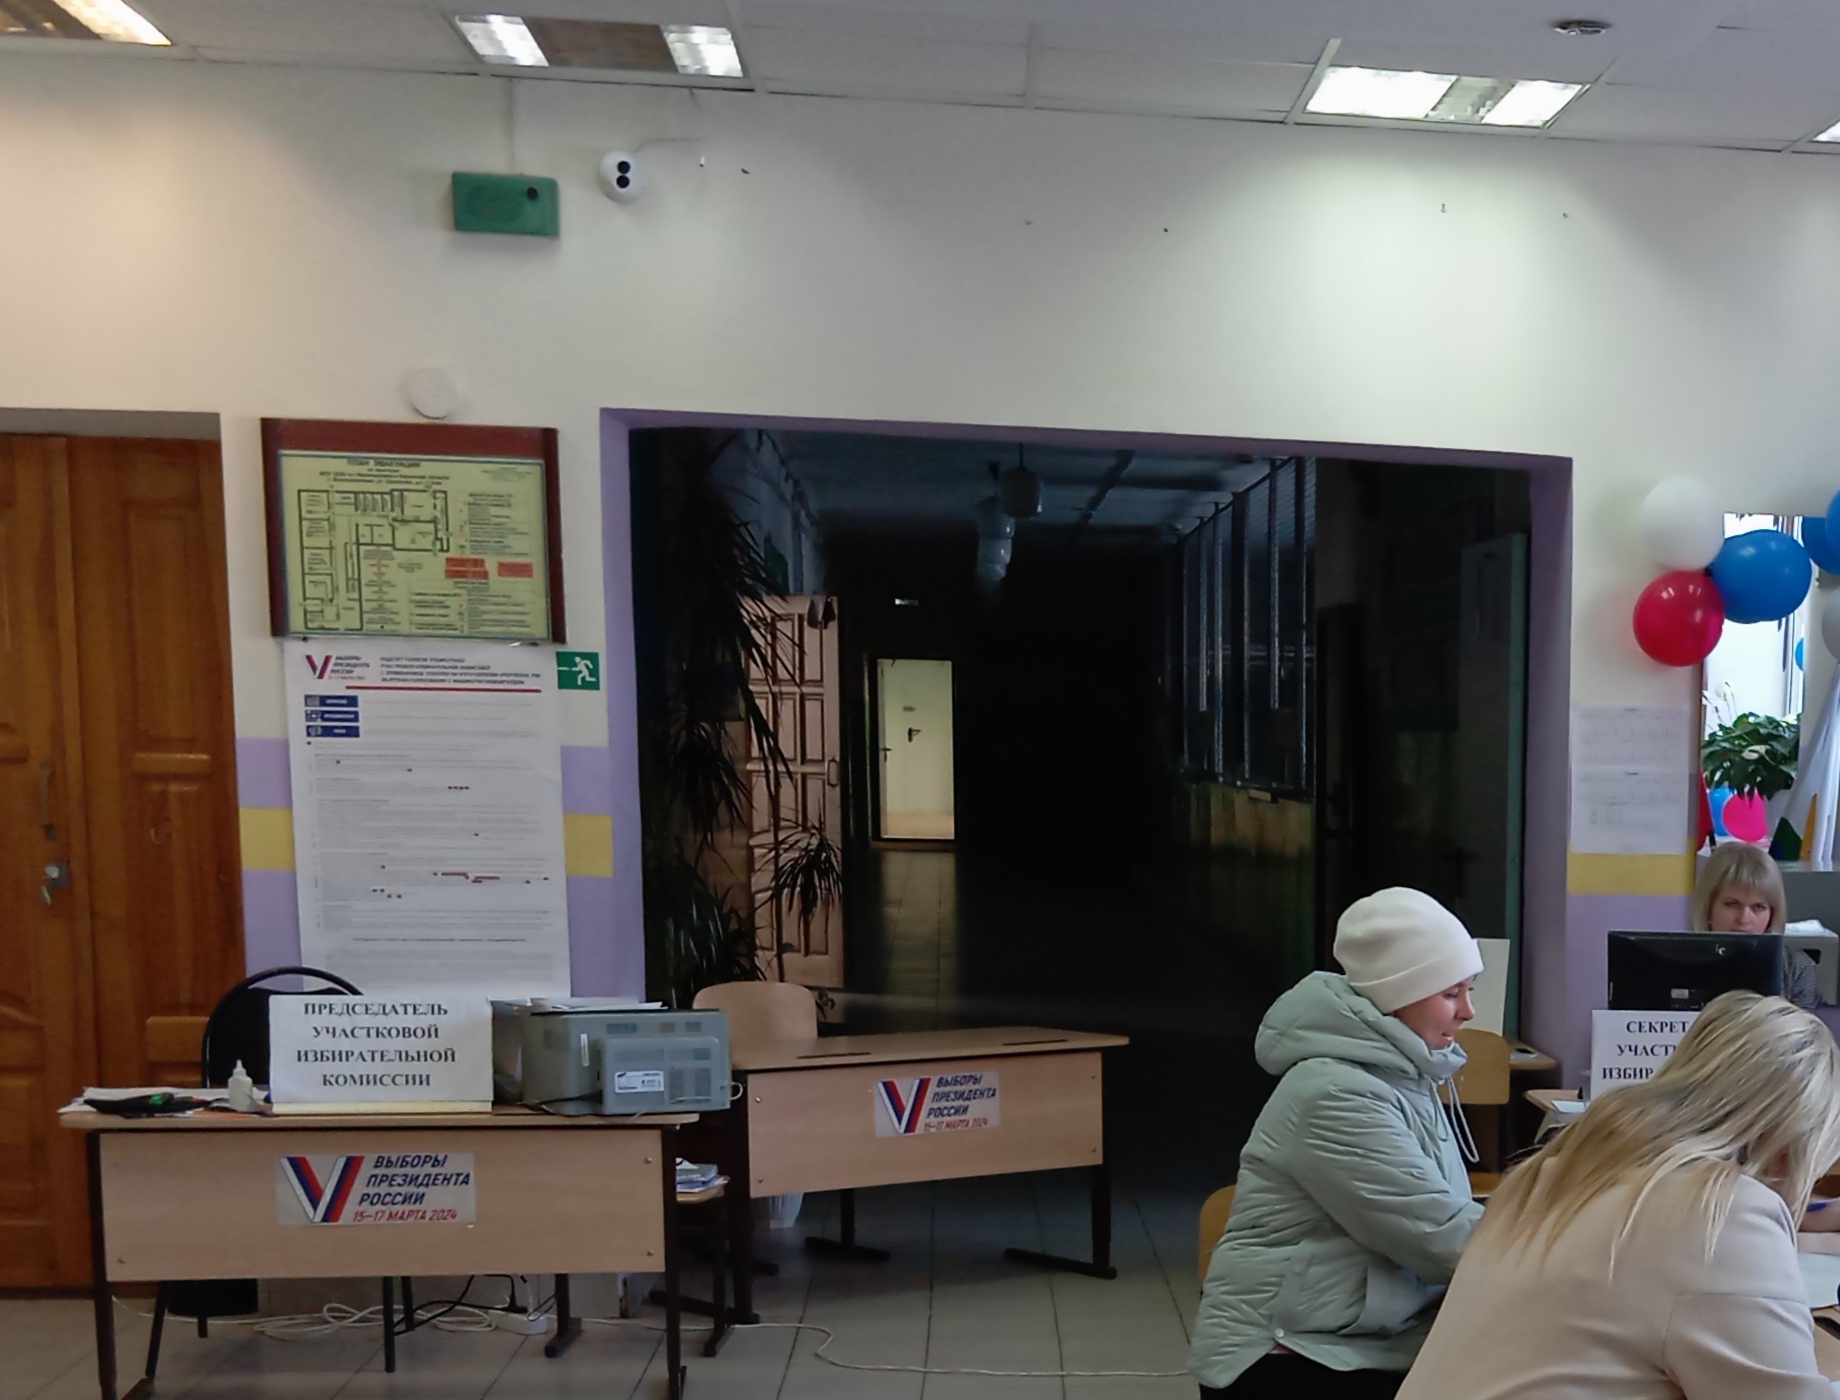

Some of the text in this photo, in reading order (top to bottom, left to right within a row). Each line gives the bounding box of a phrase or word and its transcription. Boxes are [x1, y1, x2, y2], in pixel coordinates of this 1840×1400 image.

[303, 1002, 449, 1017] ПРЕДСЕДАТЕЛЬ
[312, 1024, 440, 1039] УЧАСТКОВОЙ
[296, 1048, 457, 1063] ИЗБИРАТЕЛЬНОЙ
[321, 1073, 432, 1088] КОМИССИИ
[936, 1074, 983, 1089] ВЫБОРЫ
[931, 1087, 997, 1104] ПРЕЗИДЕНТА
[926, 1104, 970, 1119] РОССИИ
[373, 1154, 448, 1169] ВЫБОРЫ
[366, 1172, 471, 1188] ПРЕЗИДЕНТА
[358, 1192, 426, 1206] РОССИИ
[387, 1209, 427, 1222] МАРТА
[429, 1208, 458, 1221] 2024
